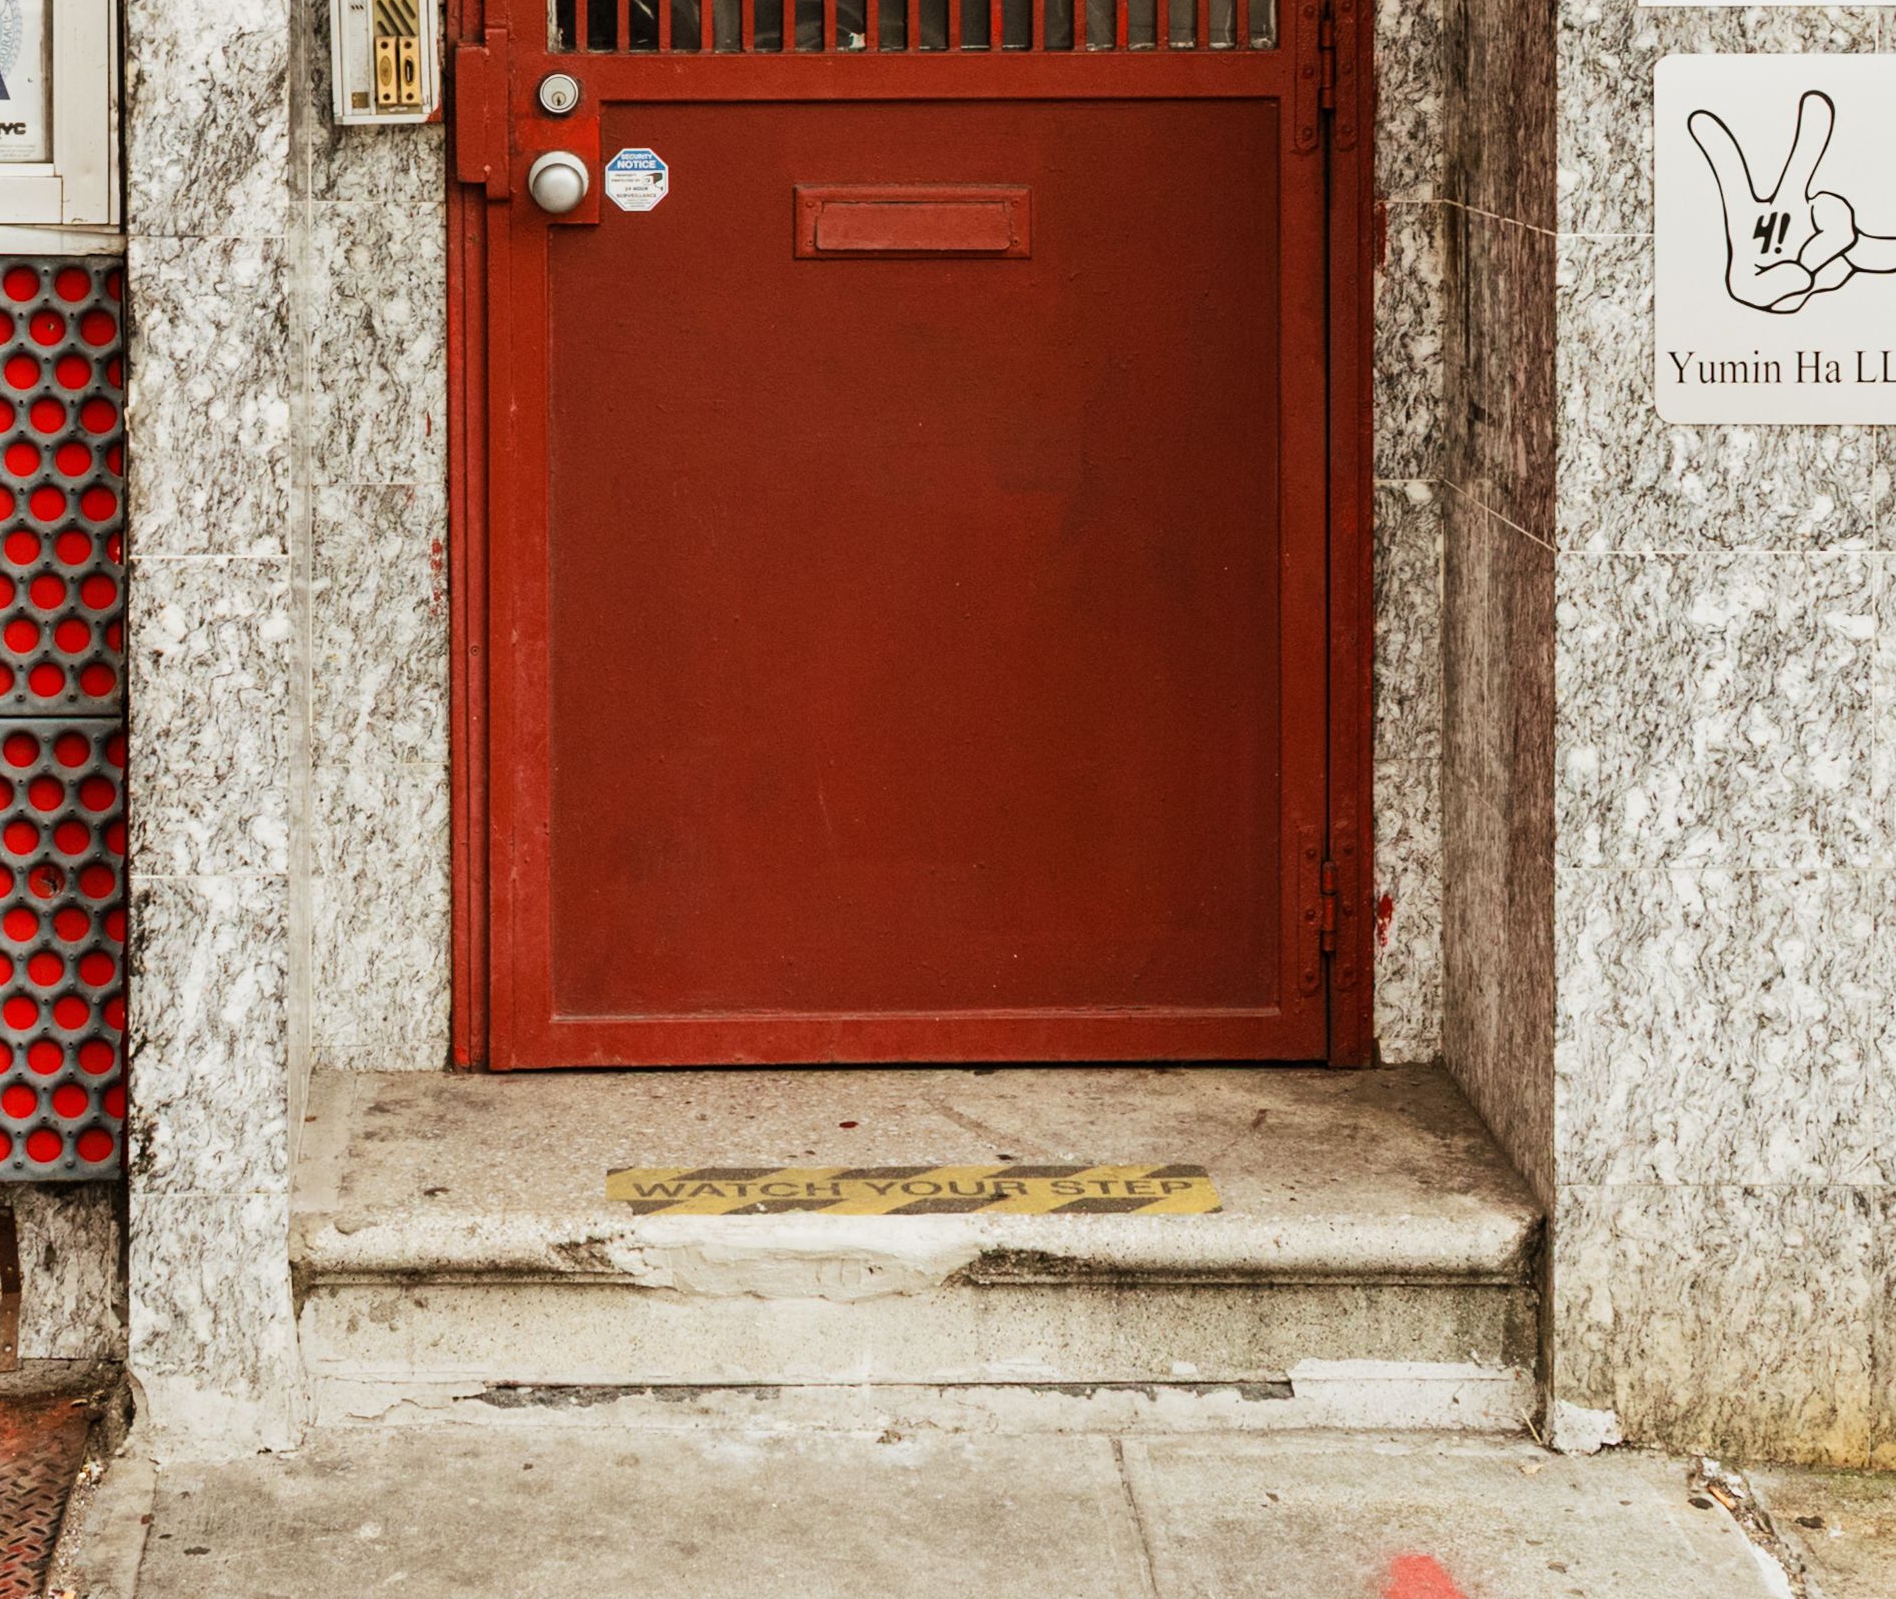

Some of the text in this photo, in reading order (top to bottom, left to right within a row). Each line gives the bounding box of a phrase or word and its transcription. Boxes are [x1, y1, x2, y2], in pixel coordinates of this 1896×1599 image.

[617, 160, 656, 169] NOTICE
[1668, 349, 1782, 384] Yumin
[1794, 350, 1841, 384] Ha
[632, 1179, 1194, 1202] WATCH YOUR STEP
